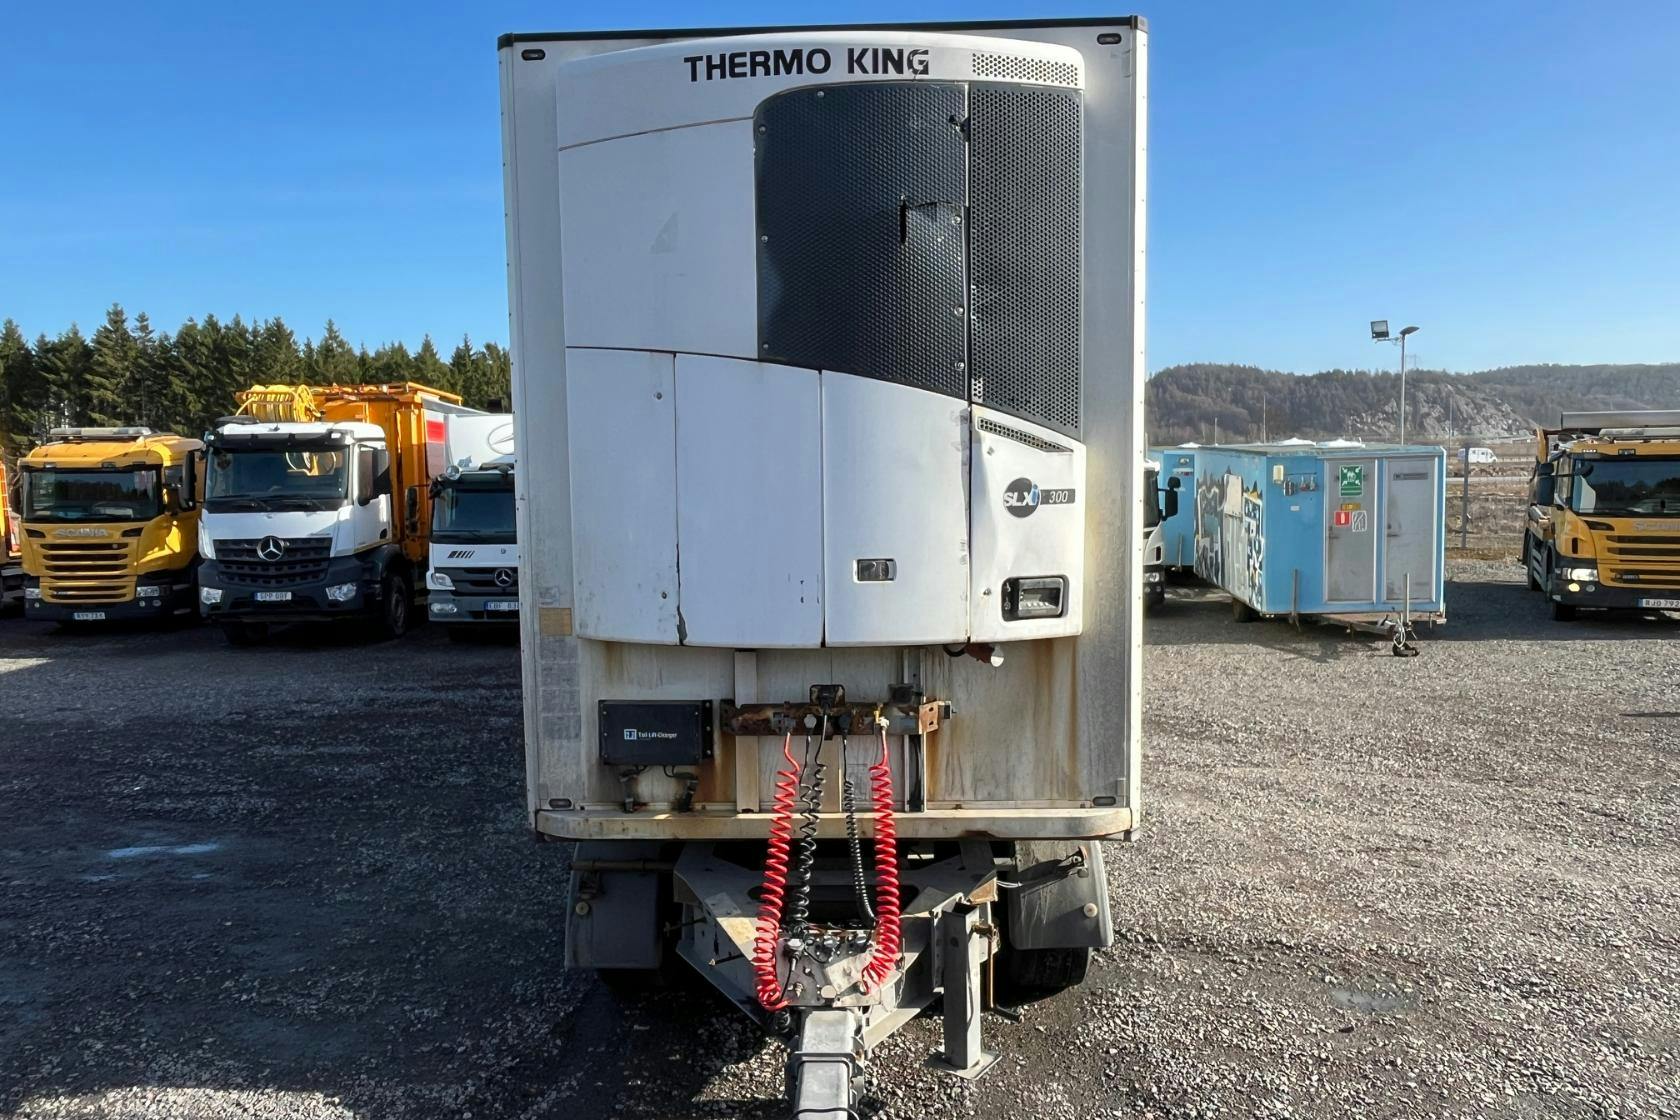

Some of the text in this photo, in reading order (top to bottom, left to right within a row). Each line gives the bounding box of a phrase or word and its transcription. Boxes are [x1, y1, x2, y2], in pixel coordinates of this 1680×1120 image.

[684, 47, 930, 82] THERMO KING
[1048, 491, 1069, 504] 300
